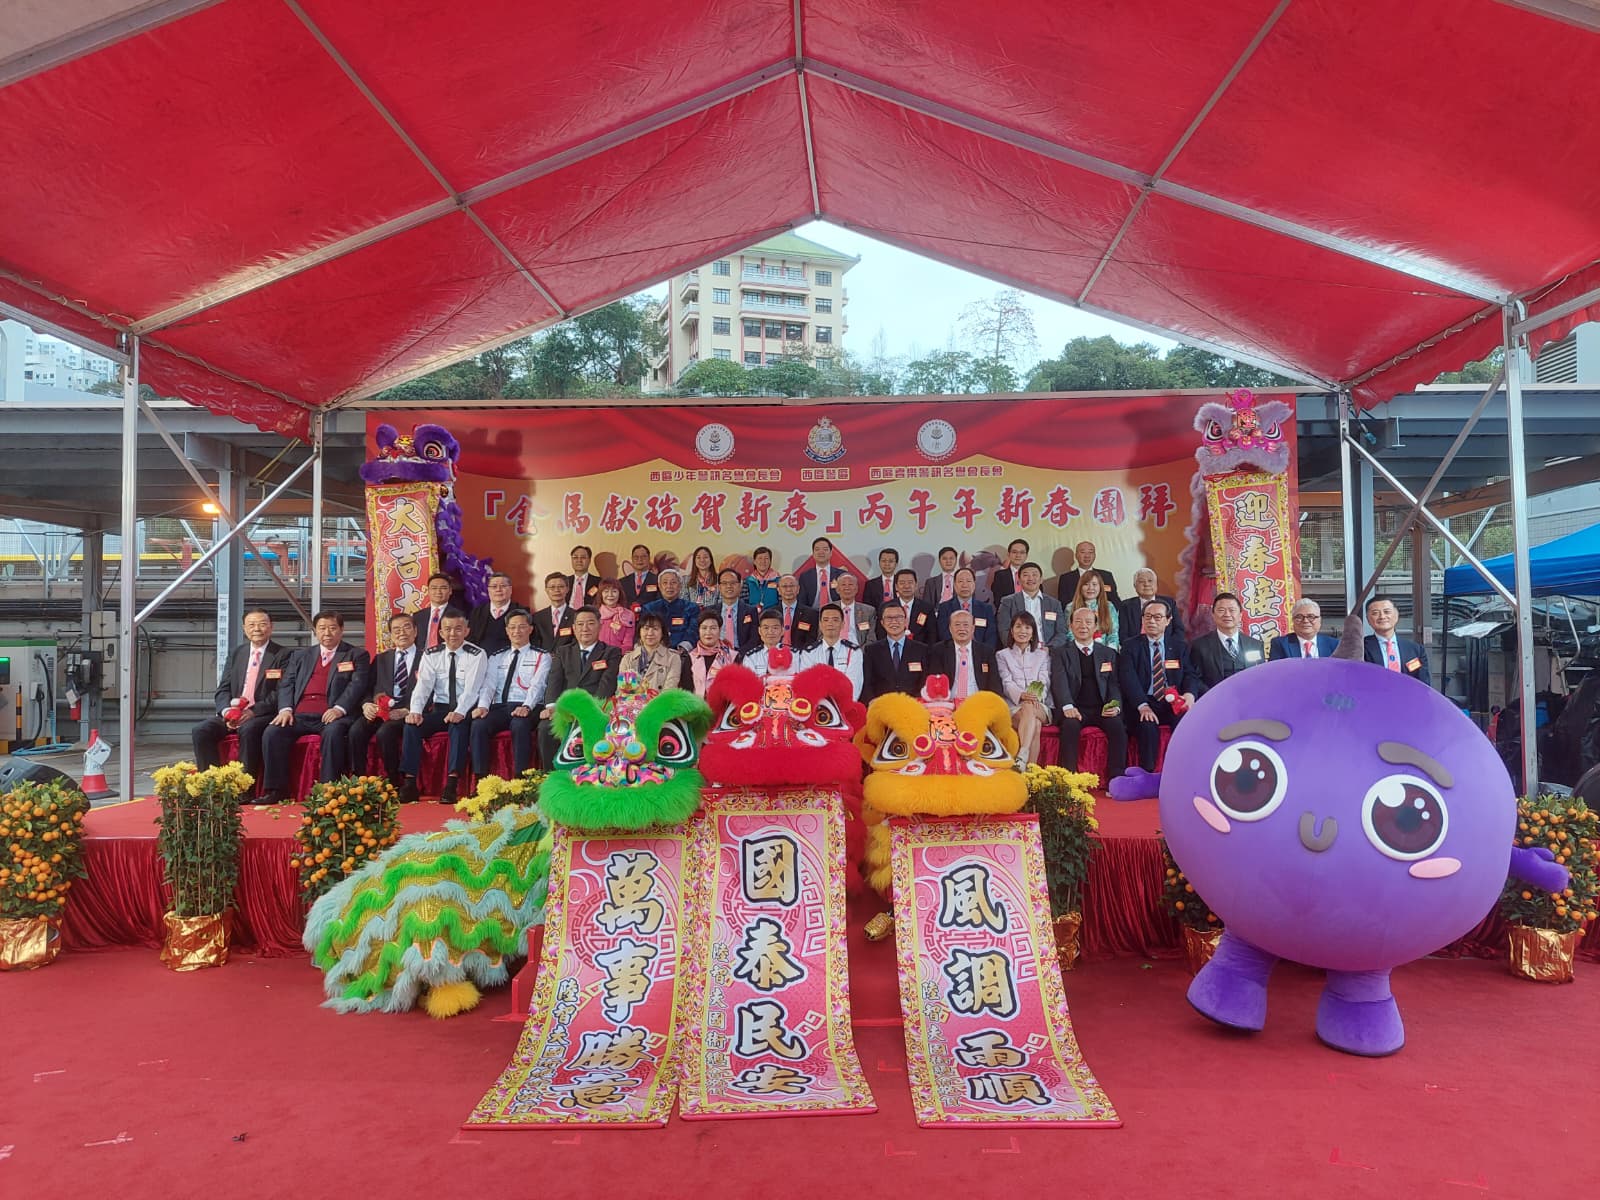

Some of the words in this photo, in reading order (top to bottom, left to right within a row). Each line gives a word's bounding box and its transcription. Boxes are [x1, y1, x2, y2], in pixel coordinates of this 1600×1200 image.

[550, 851, 664, 1110] 萬事勝意
[732, 835, 815, 1095] 國泰民安
[938, 863, 1052, 1106] 風調雨順
